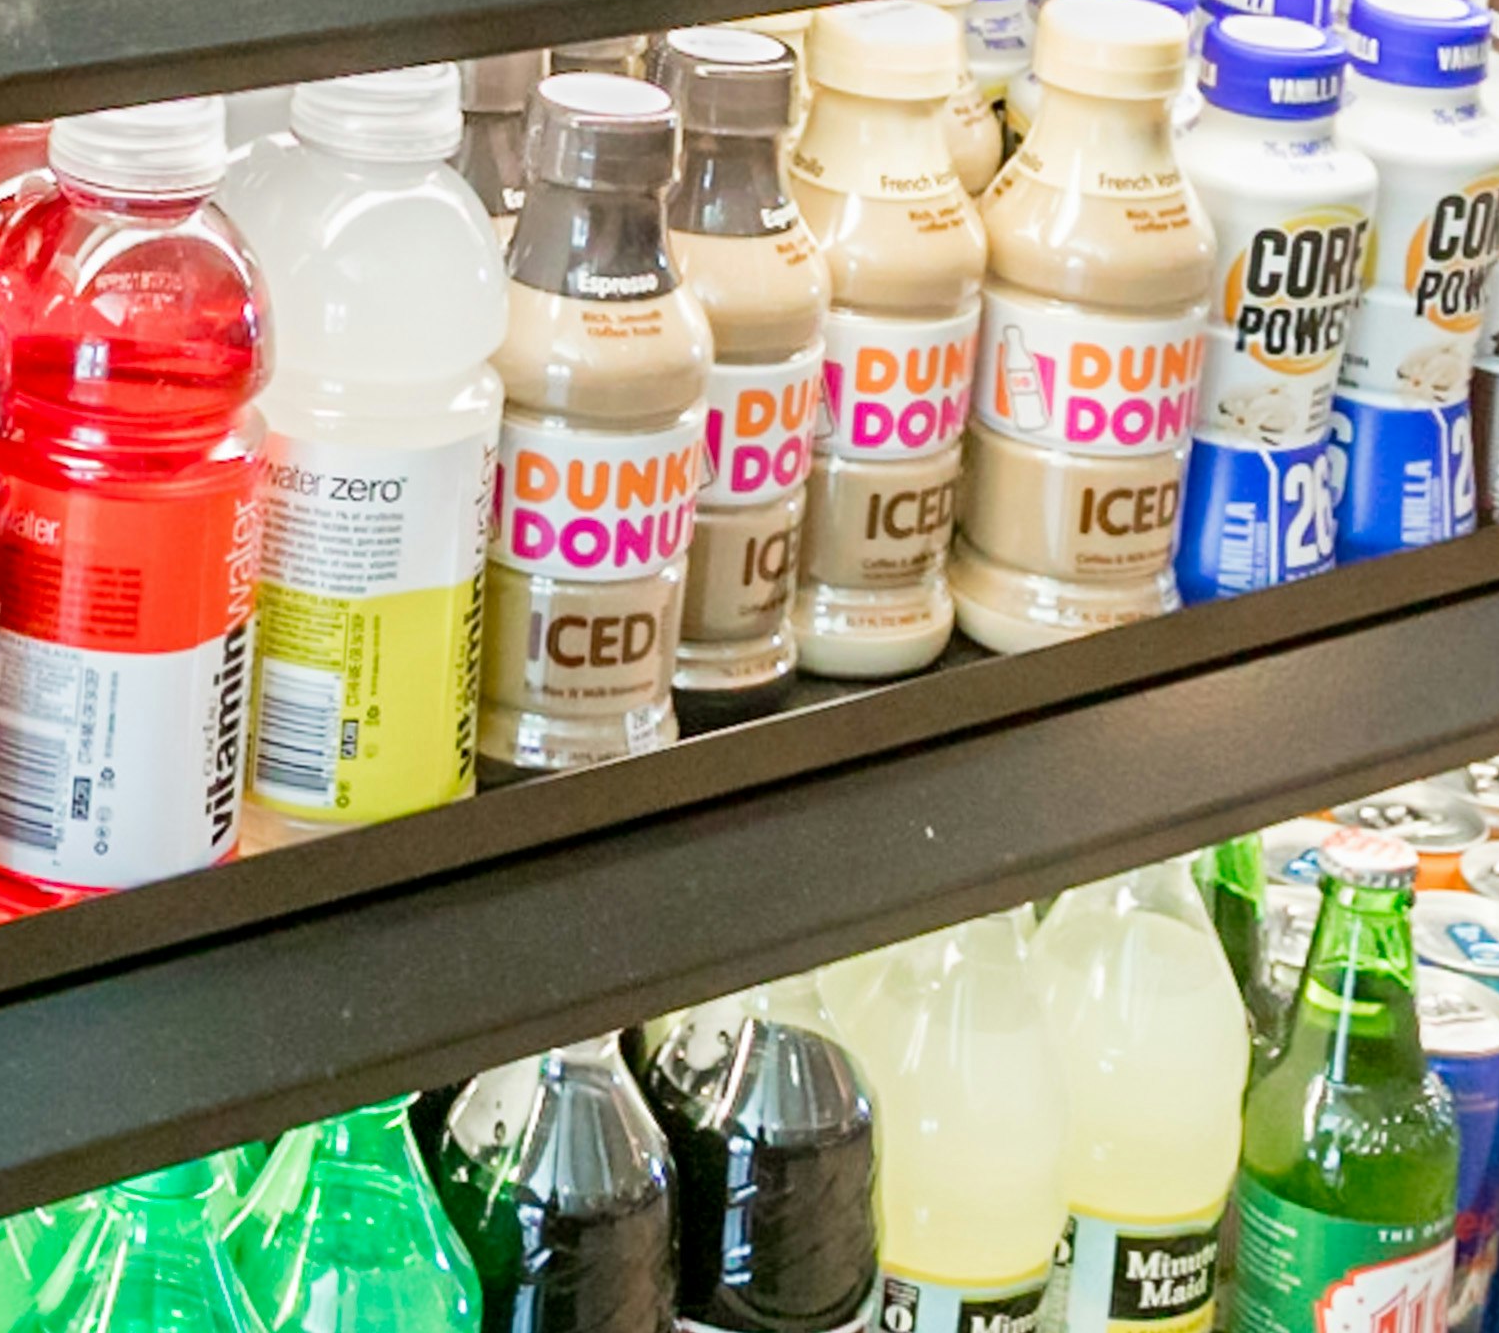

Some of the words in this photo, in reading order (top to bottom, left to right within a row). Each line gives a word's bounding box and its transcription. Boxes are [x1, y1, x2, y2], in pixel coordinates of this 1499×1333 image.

[880, 173, 934, 194] French
[1097, 171, 1153, 192] French
[577, 269, 659, 301] Espresso
[1246, 219, 1368, 299] CORE
[329, 475, 405, 503] zero
[865, 486, 956, 540] ICED
[1080, 480, 1180, 536] ICED
[1282, 454, 1336, 570] 26
[527, 610, 656, 669] ICED
[205, 499, 260, 848] vitaminwater
